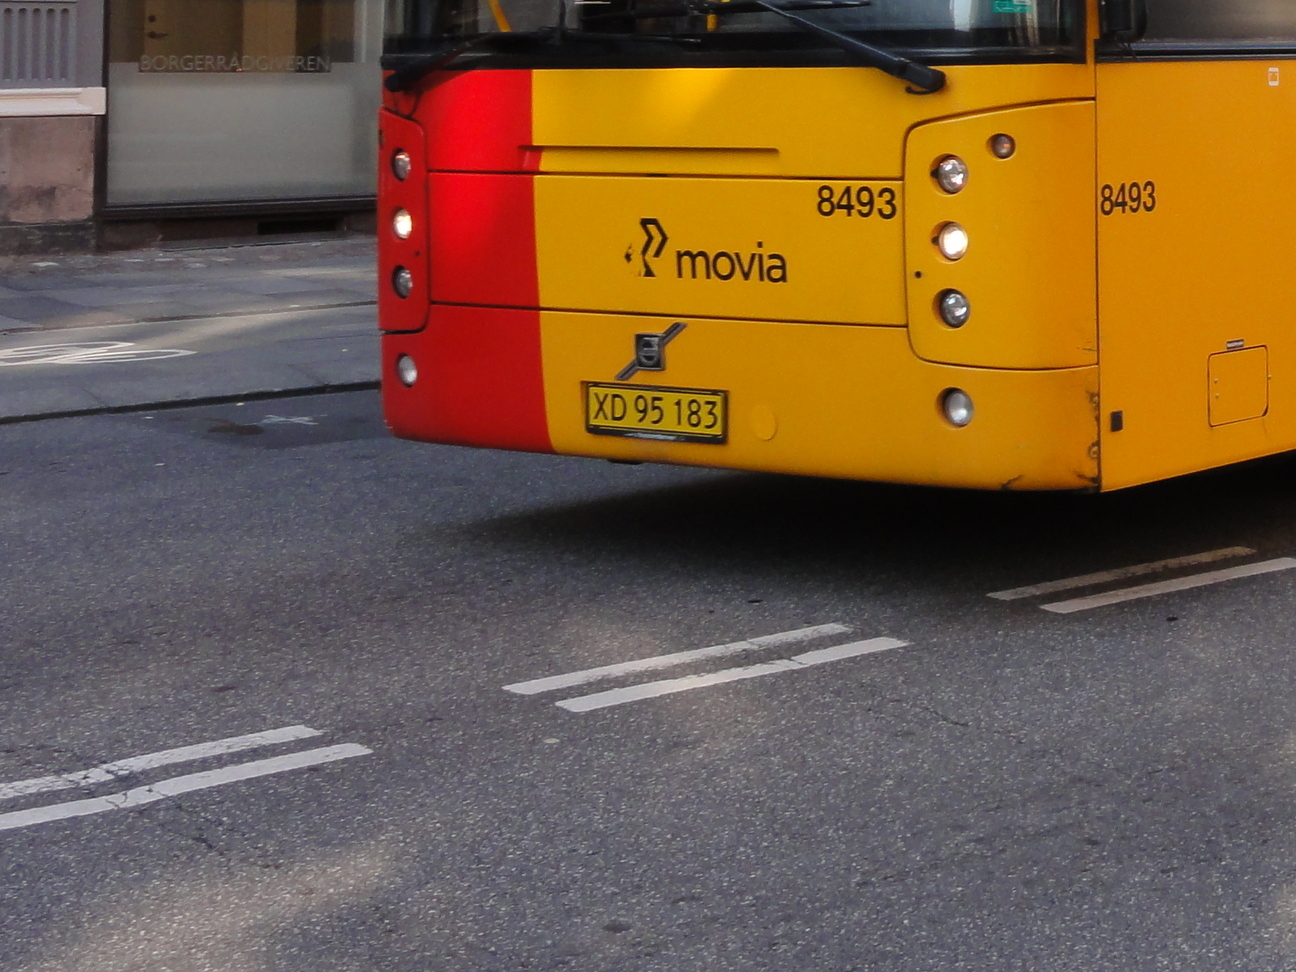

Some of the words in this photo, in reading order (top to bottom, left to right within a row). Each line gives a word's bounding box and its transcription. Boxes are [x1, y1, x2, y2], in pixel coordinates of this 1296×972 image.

[817, 185, 897, 220] 8493
[1101, 180, 1156, 216] 8493
[676, 241, 788, 283] movia
[594, 392, 627, 421] XD
[634, 394, 664, 424] 95
[674, 398, 718, 429] 183
